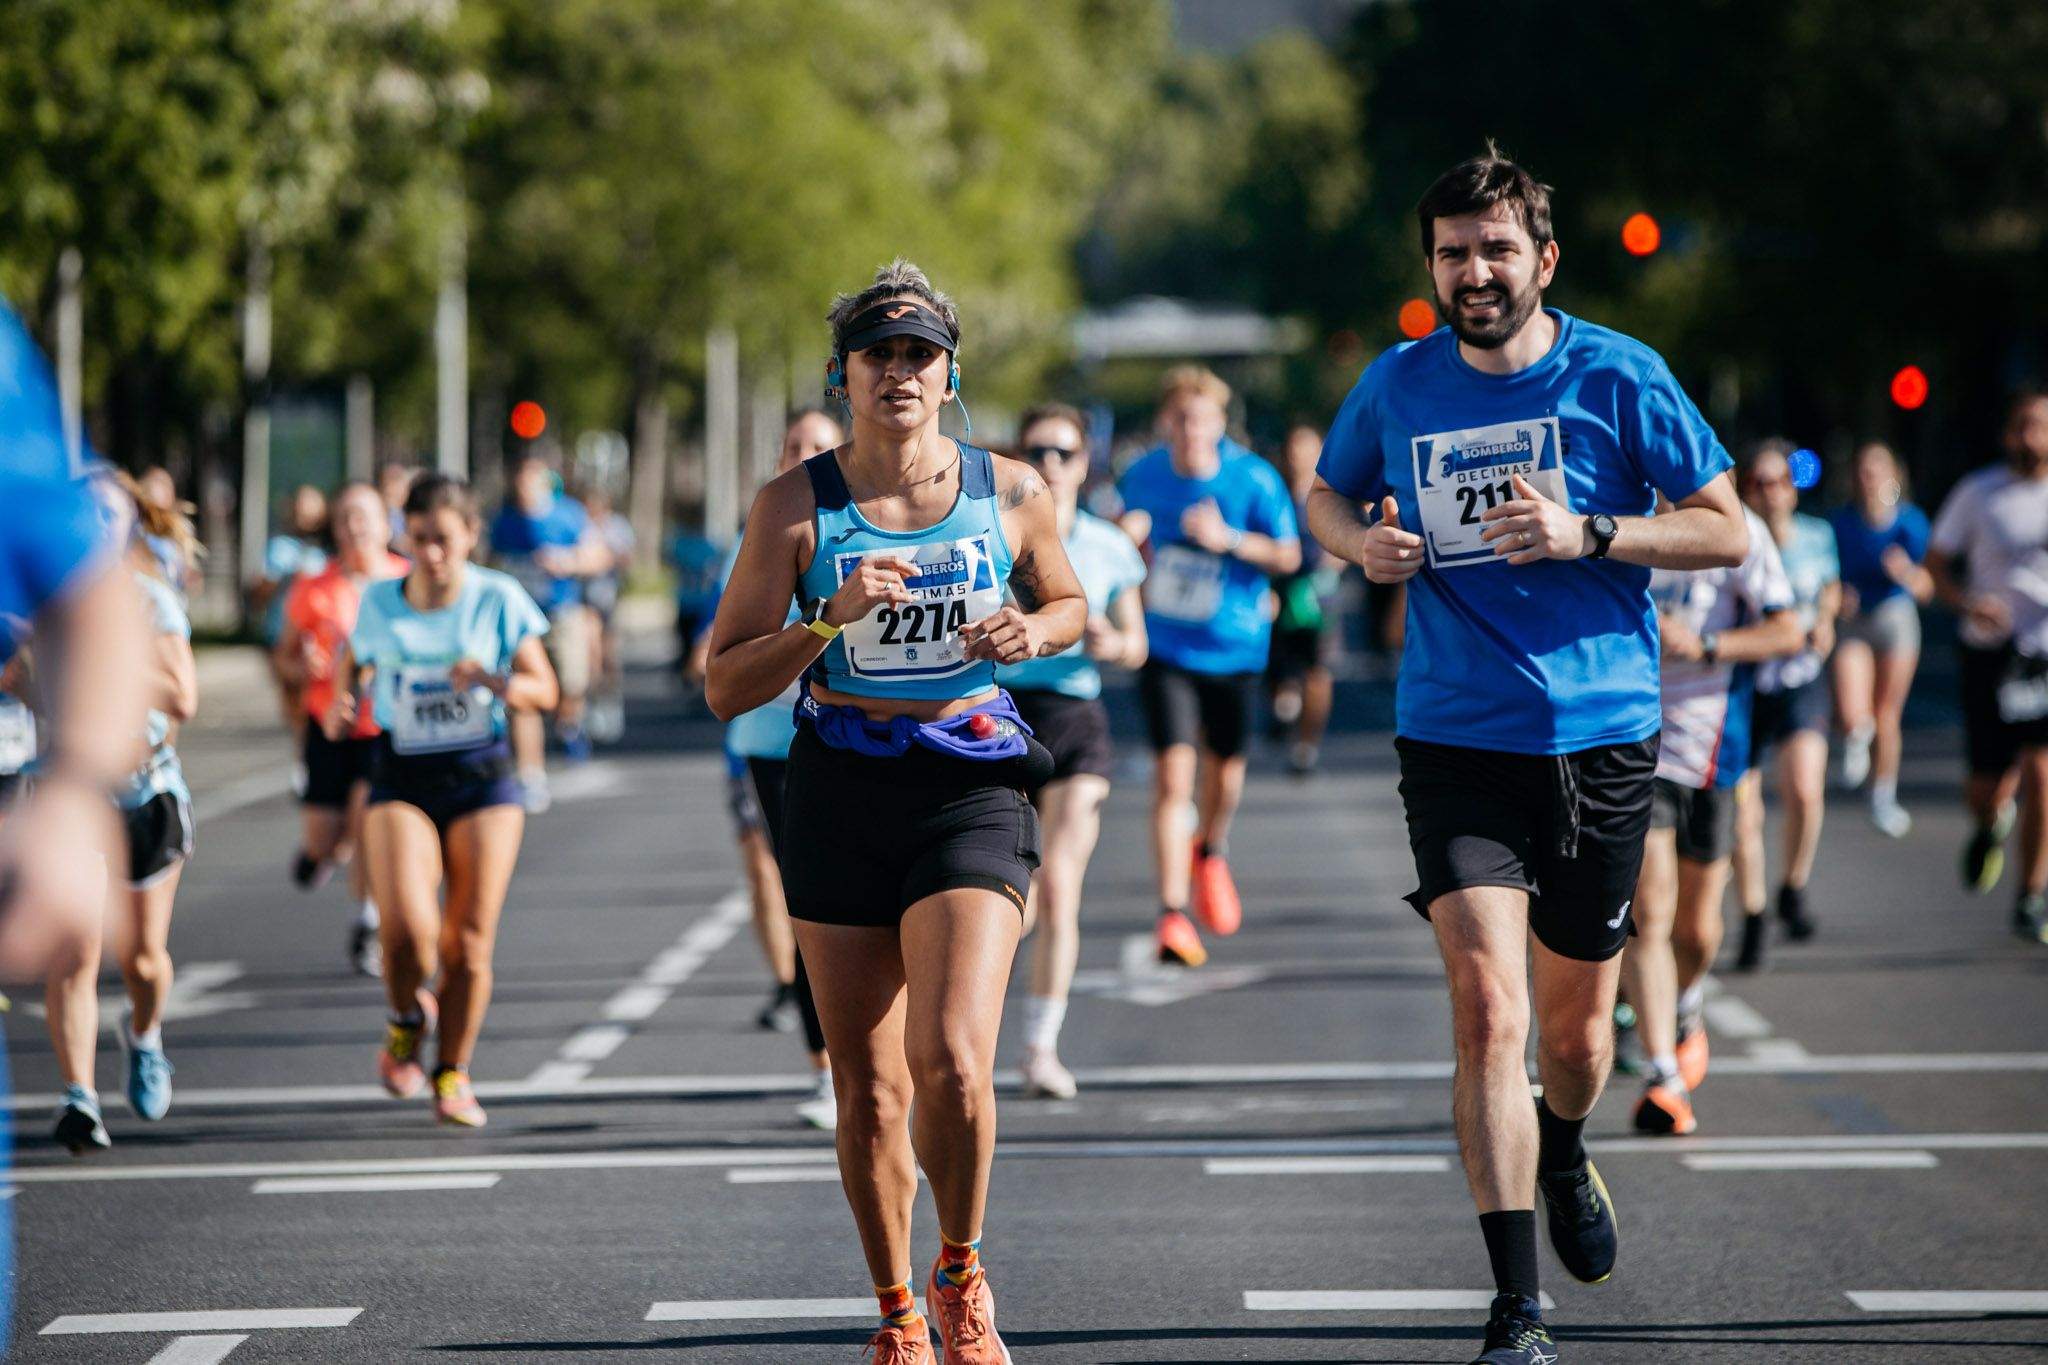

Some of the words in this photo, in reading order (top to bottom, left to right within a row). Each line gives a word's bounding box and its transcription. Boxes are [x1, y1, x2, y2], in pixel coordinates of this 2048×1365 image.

[1461, 441, 1530, 460] BOMBEROS
[1457, 463, 1532, 484] DECIMAS
[1456, 478, 1528, 525] 211
[920, 560, 965, 576] BEROS
[877, 599, 968, 645] 2274
